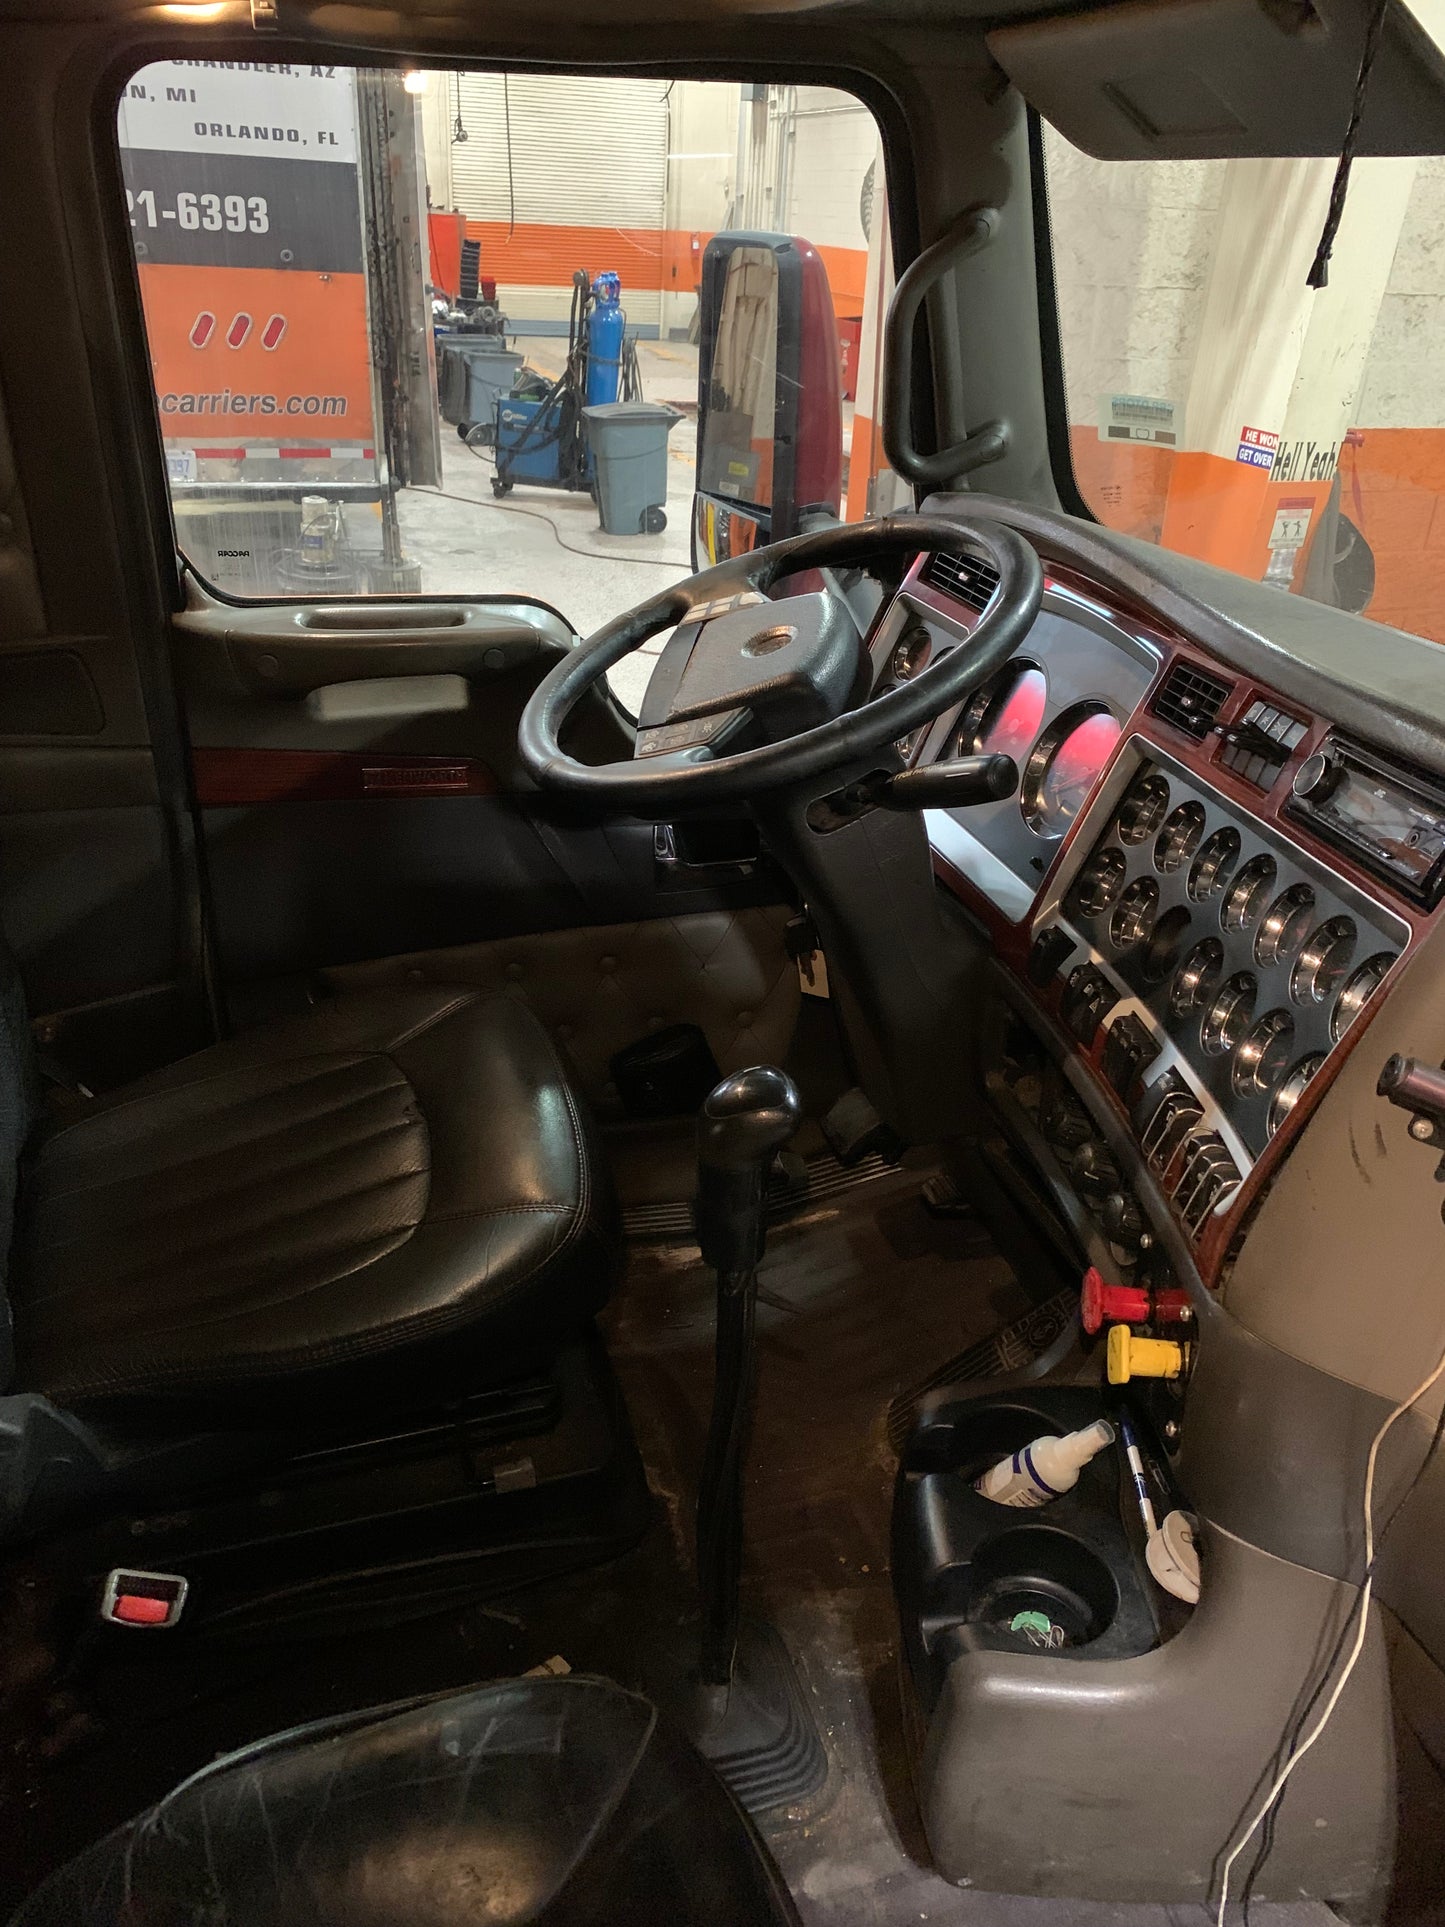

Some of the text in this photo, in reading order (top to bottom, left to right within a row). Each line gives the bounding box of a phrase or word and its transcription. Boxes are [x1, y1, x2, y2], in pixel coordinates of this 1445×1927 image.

[310, 65, 336, 79] AZ
[166, 87, 196, 103] MI
[194, 121, 339, 146] ORLANDO, FL
[157, 389, 347, 416] carriers.com
[1245, 429, 1279, 449] HE WON
[1239, 448, 1273, 468] GET OVER
[1270, 441, 1305, 482] Hell
